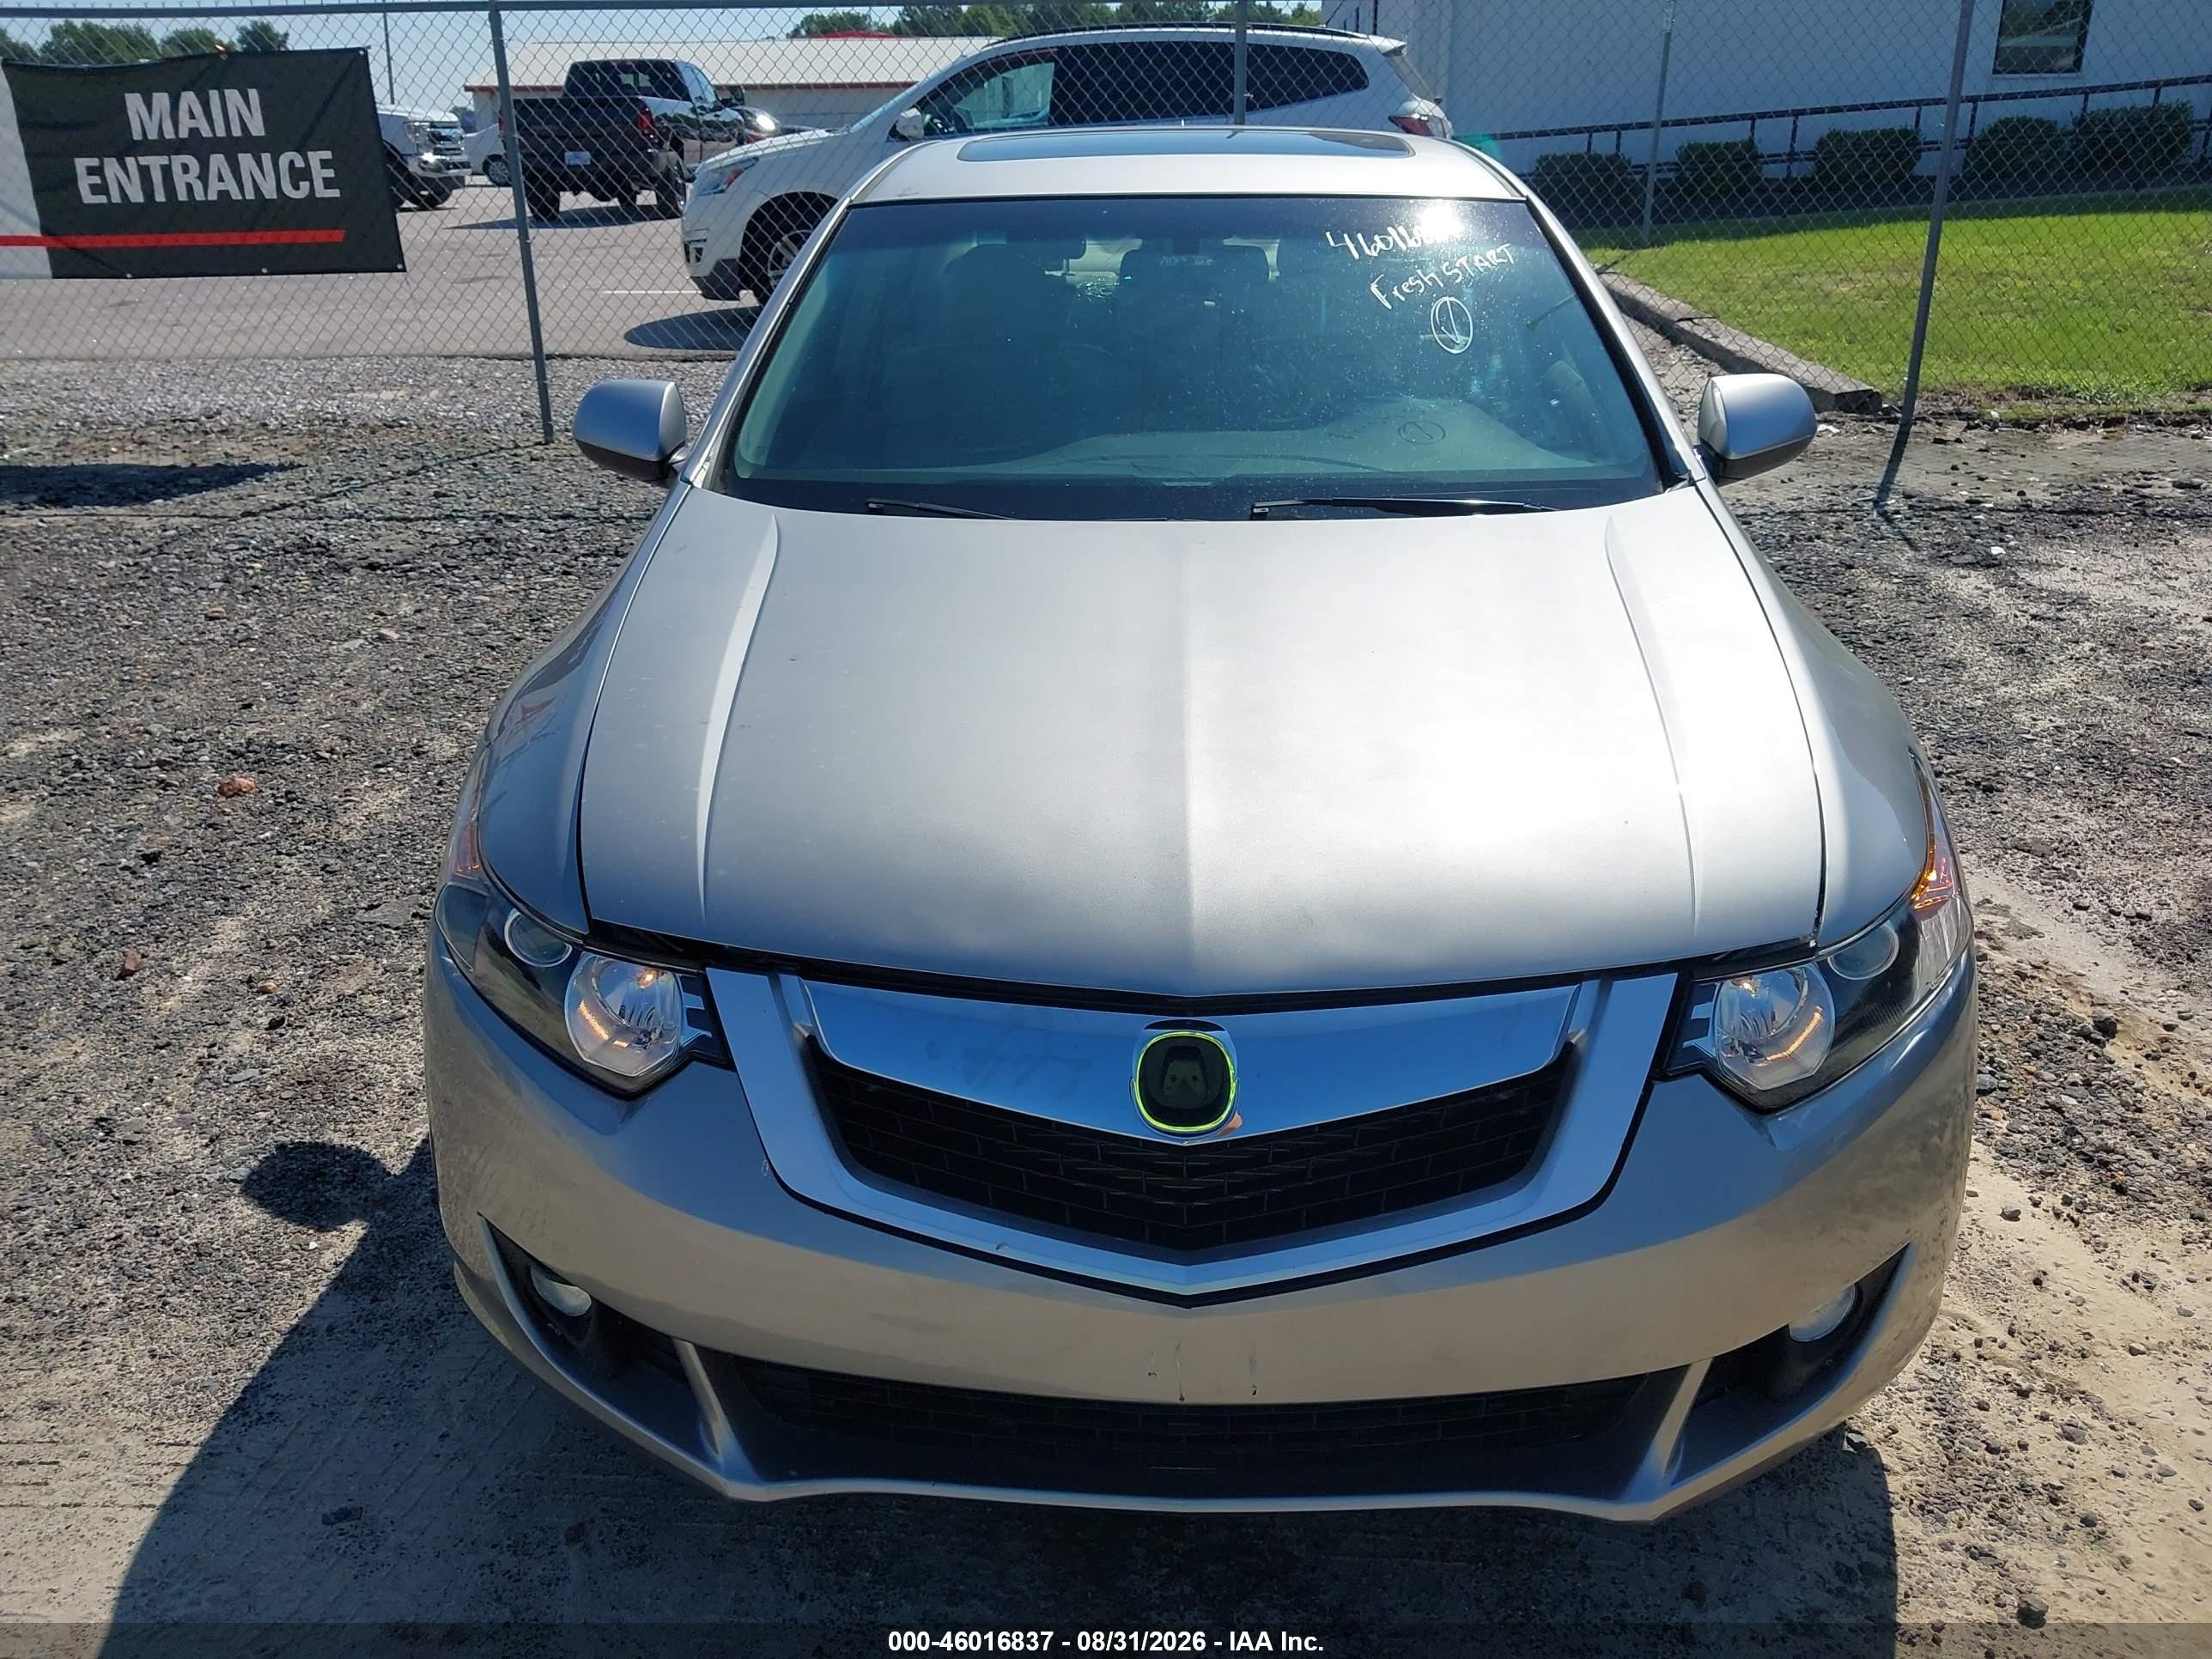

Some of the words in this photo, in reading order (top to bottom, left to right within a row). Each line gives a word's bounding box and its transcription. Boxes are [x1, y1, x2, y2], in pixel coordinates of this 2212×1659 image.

[125, 88, 265, 140] MAIN
[74, 150, 341, 204] ENTRANCE
[1370, 270, 1444, 310] Fresh
[1442, 242, 1517, 283] START
